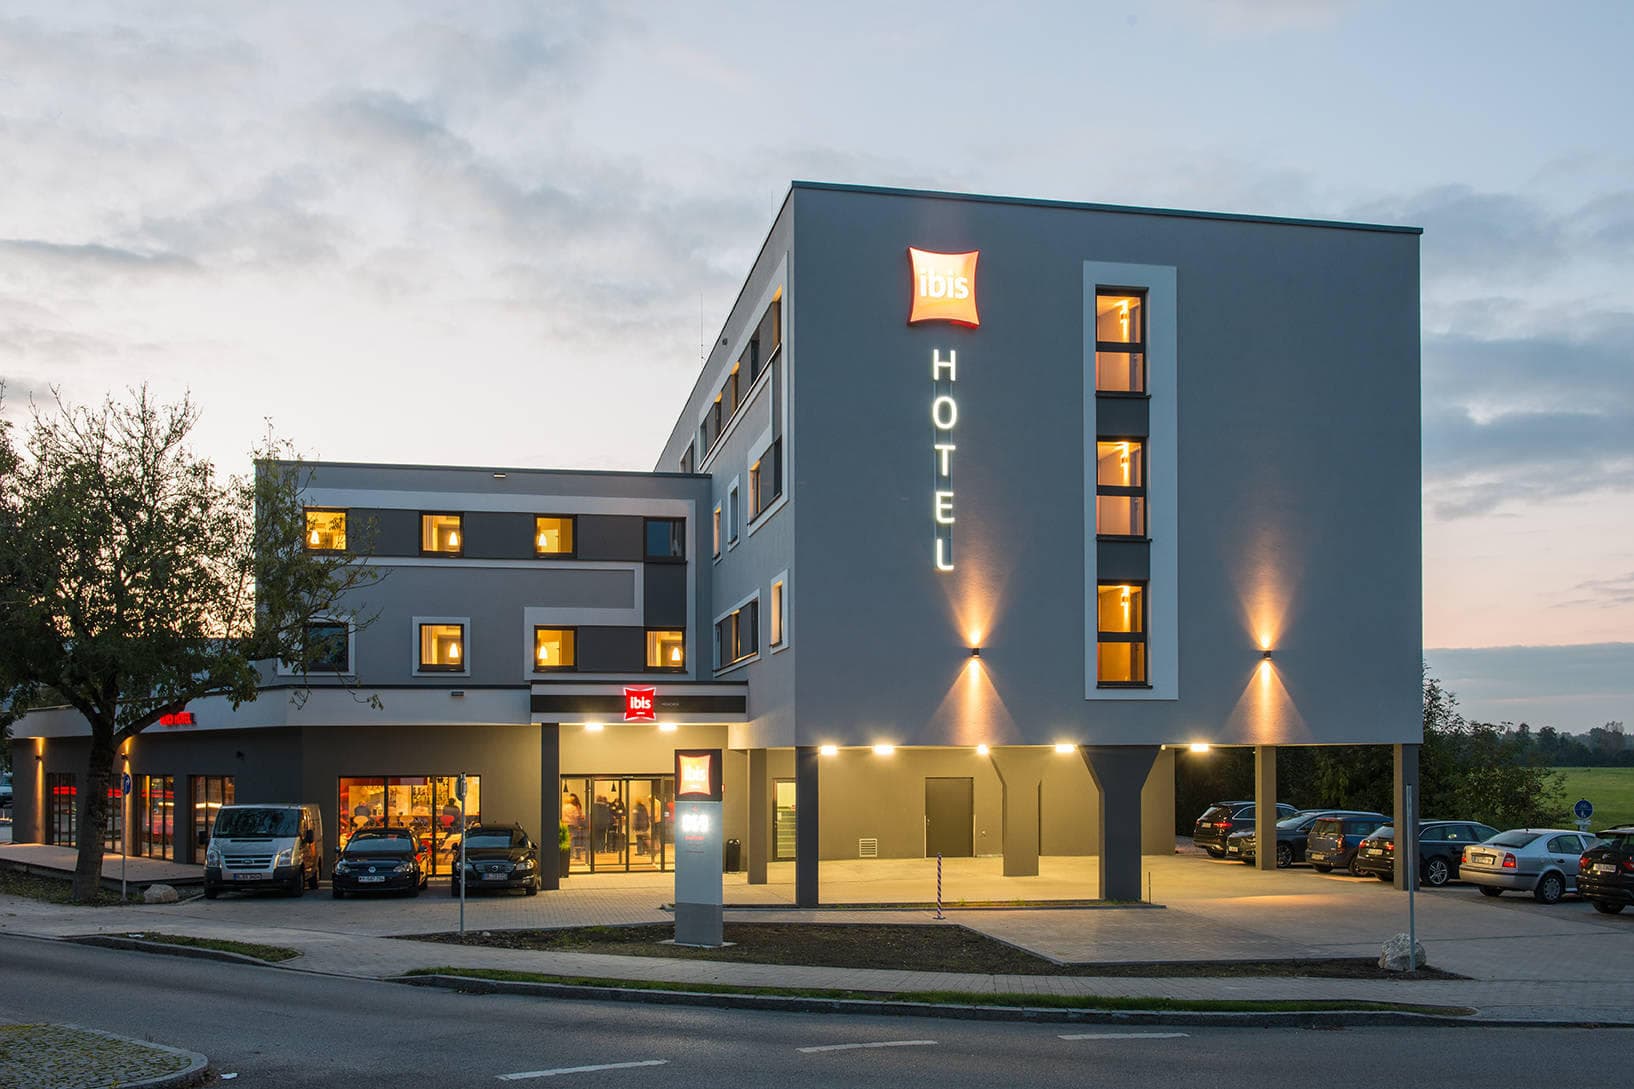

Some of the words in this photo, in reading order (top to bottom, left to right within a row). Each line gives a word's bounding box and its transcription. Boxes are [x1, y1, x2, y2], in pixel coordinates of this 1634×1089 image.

[919, 267, 970, 300] ibis
[932, 348, 957, 571] HOTEL
[630, 696, 652, 709] ibis
